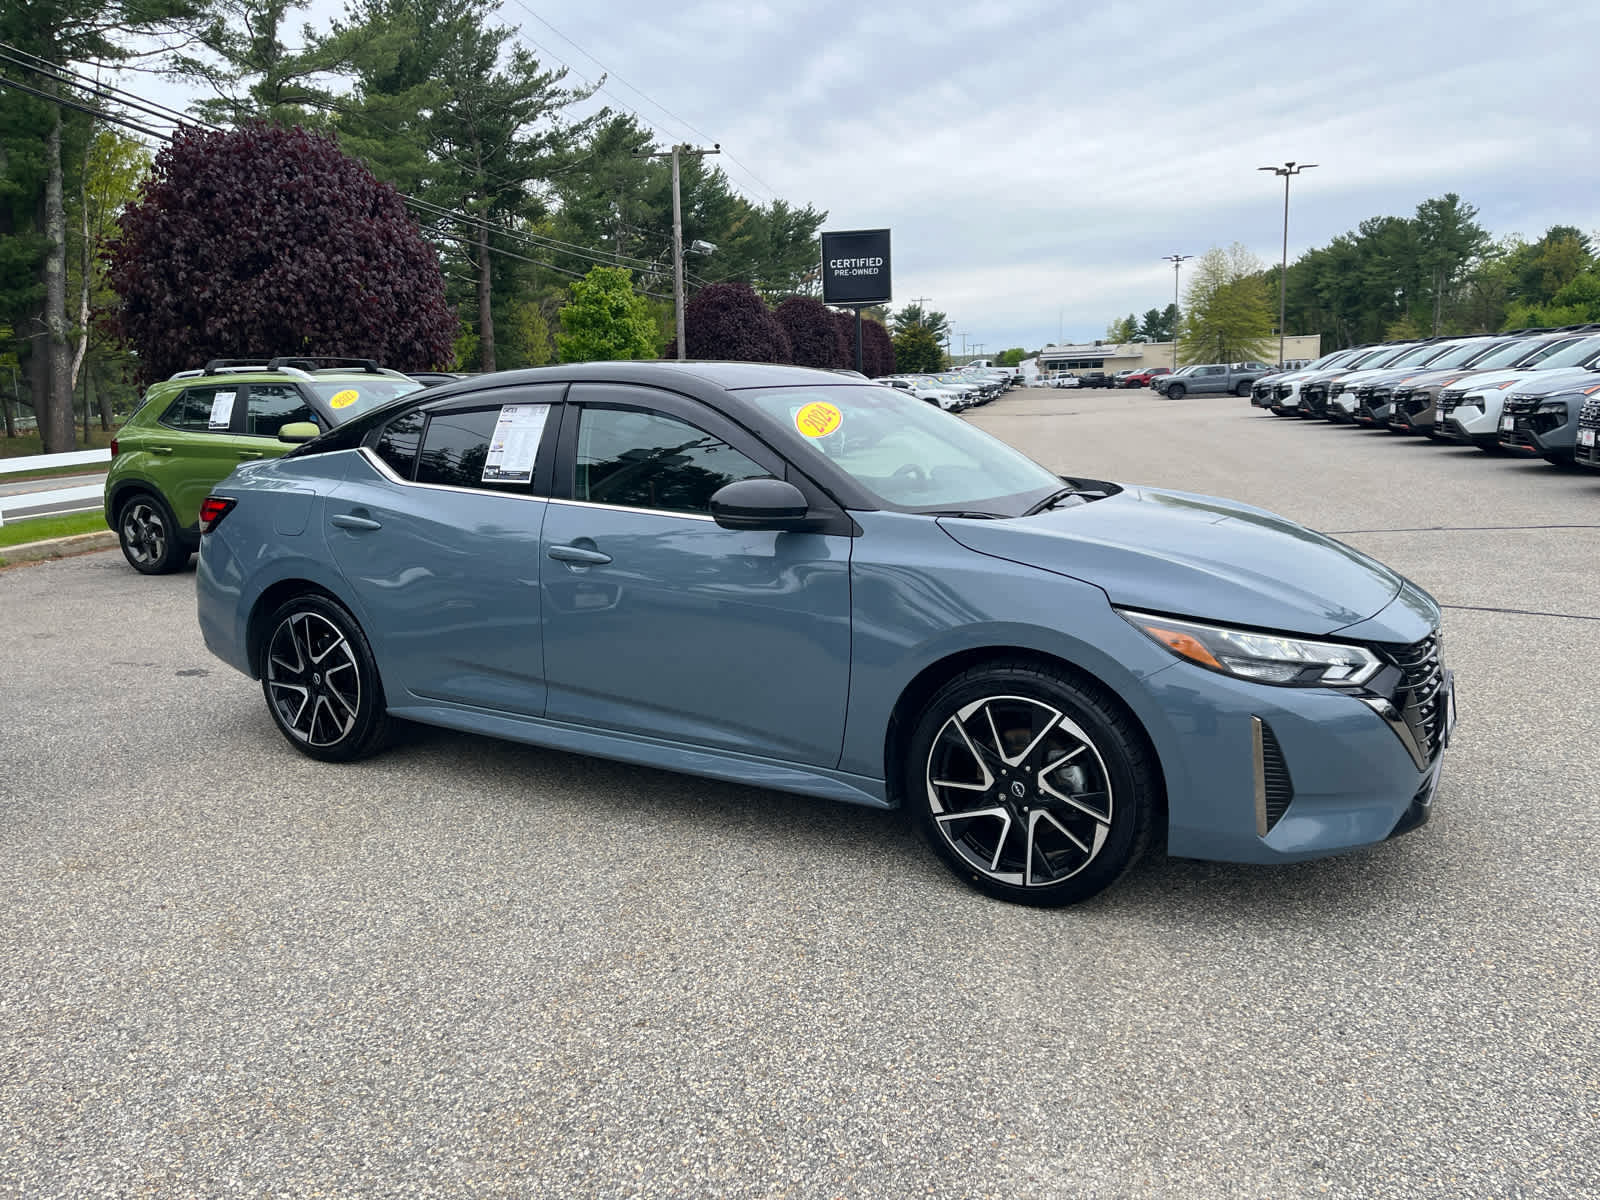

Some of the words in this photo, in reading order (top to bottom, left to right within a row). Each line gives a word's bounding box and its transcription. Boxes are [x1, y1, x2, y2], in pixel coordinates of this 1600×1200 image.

[830, 257, 883, 268] CERTIFIED
[834, 267, 879, 276] PRE-OWNED
[803, 404, 835, 432] 2024
